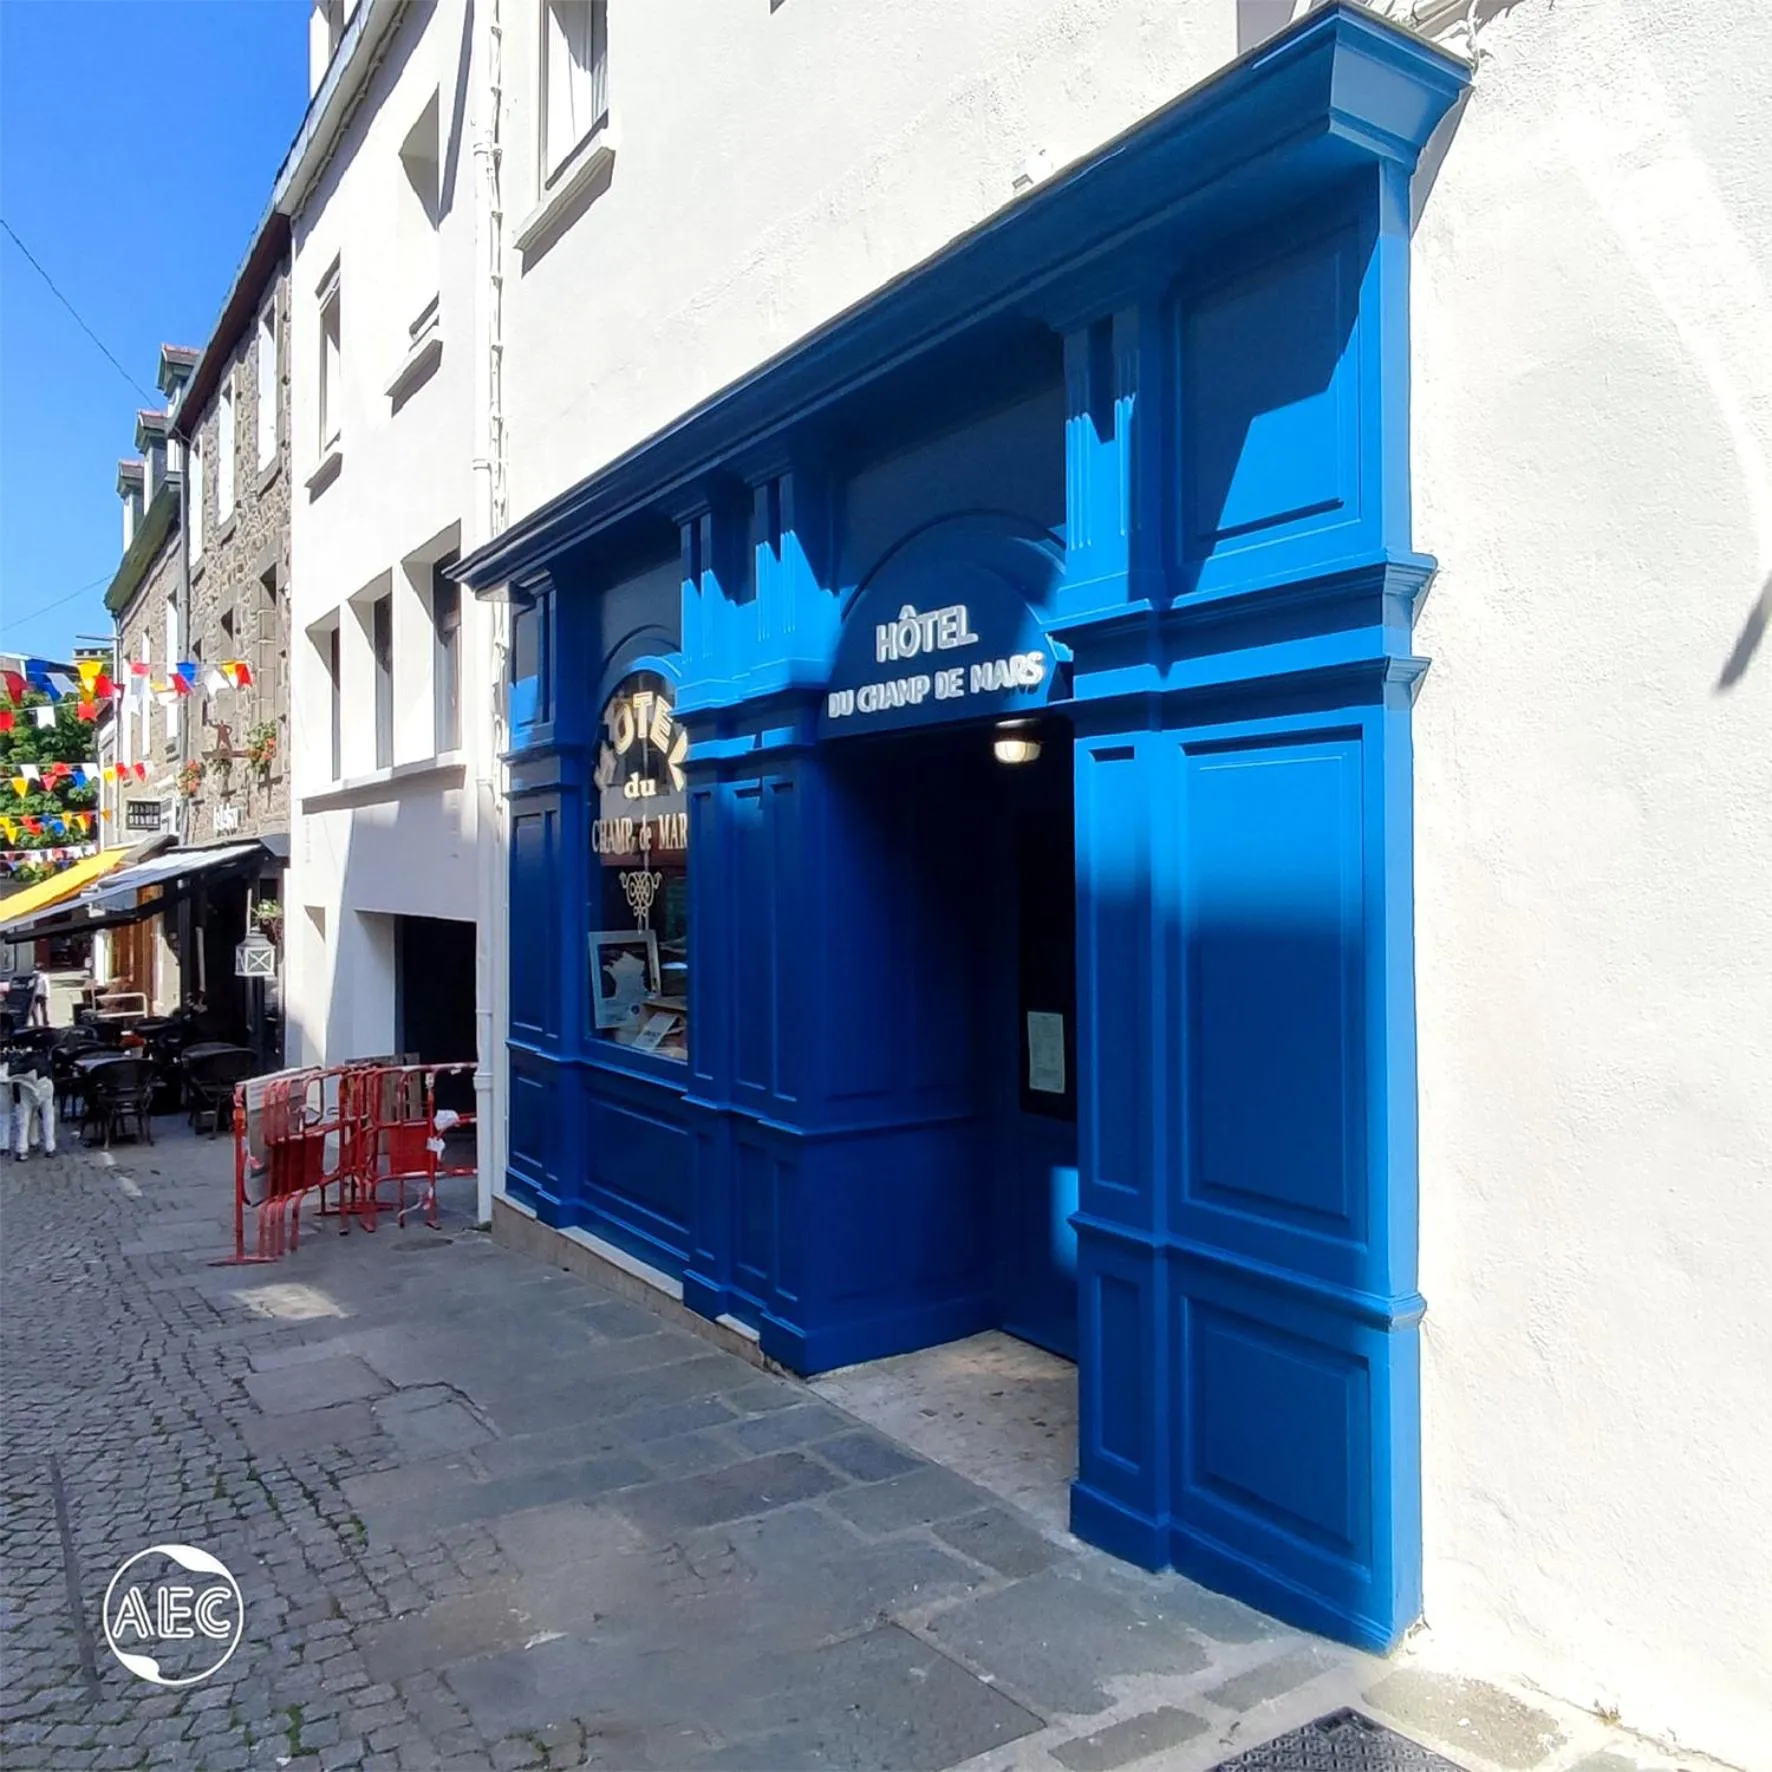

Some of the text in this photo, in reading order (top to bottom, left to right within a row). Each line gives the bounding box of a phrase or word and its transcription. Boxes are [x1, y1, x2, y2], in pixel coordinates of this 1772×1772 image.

[876, 604, 979, 663] HÔTEL
[828, 651, 1046, 718] DU CHAMP DE MARS
[624, 772, 657, 799] du
[639, 813, 652, 851] de
